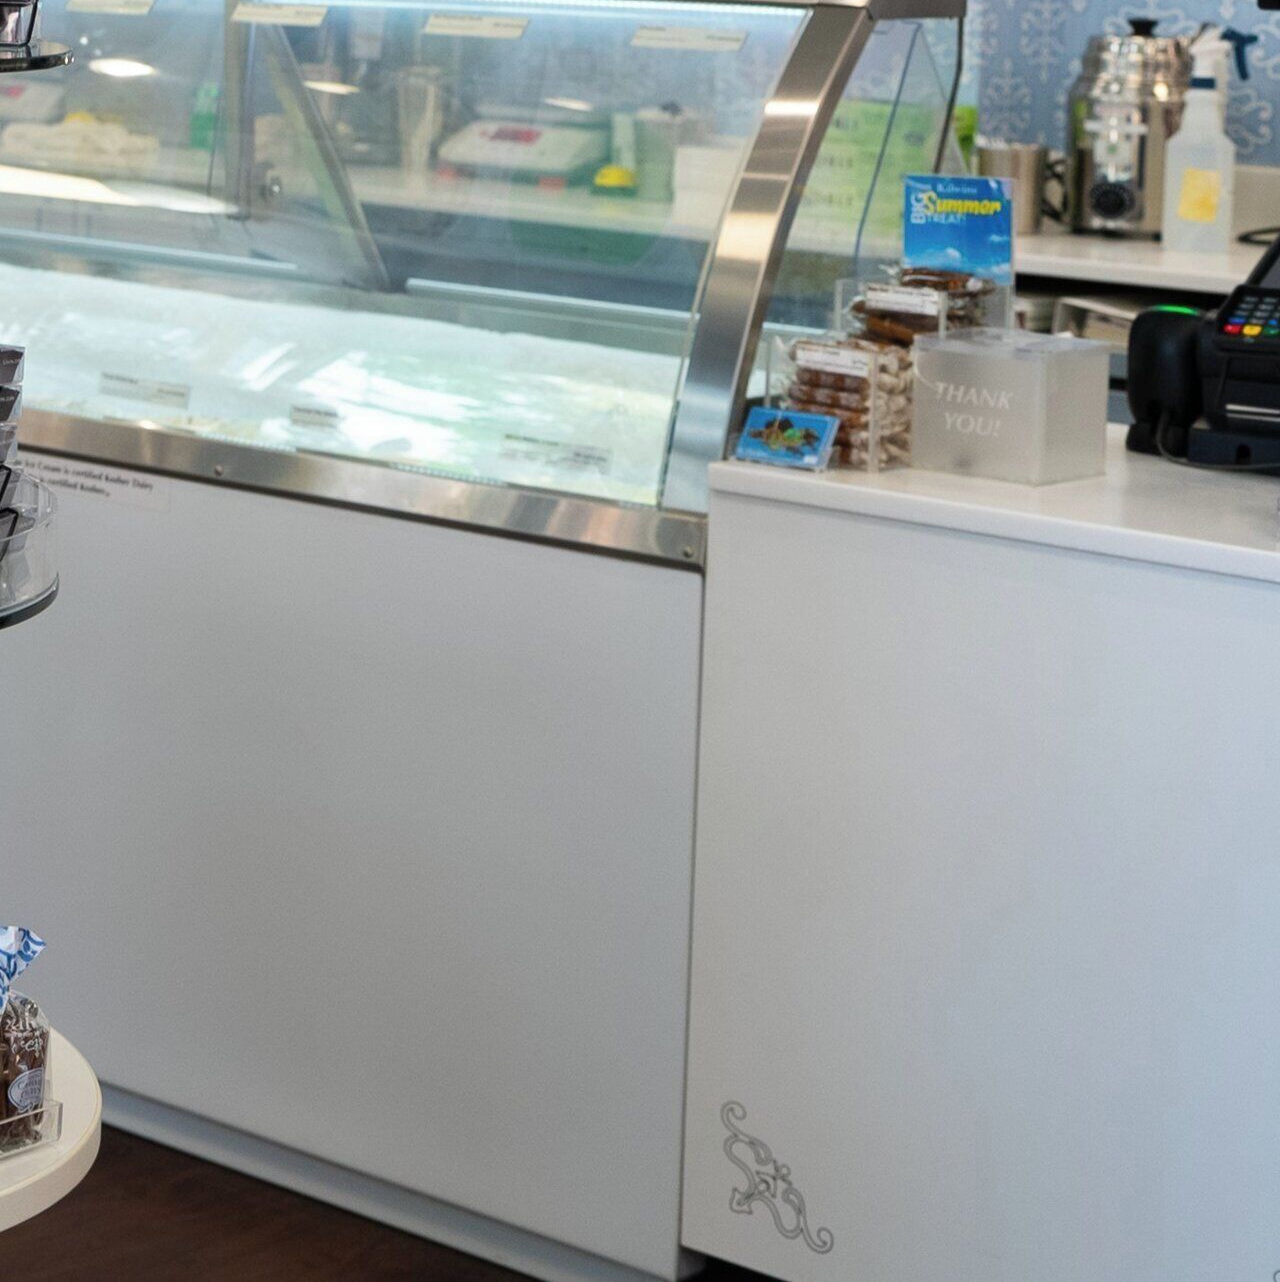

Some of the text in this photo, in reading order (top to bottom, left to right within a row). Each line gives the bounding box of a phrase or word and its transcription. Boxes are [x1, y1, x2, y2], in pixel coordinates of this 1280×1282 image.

[924, 190, 1002, 216] Summer
[936, 381, 1014, 411] THANK
[942, 412, 1002, 438] YOU!
